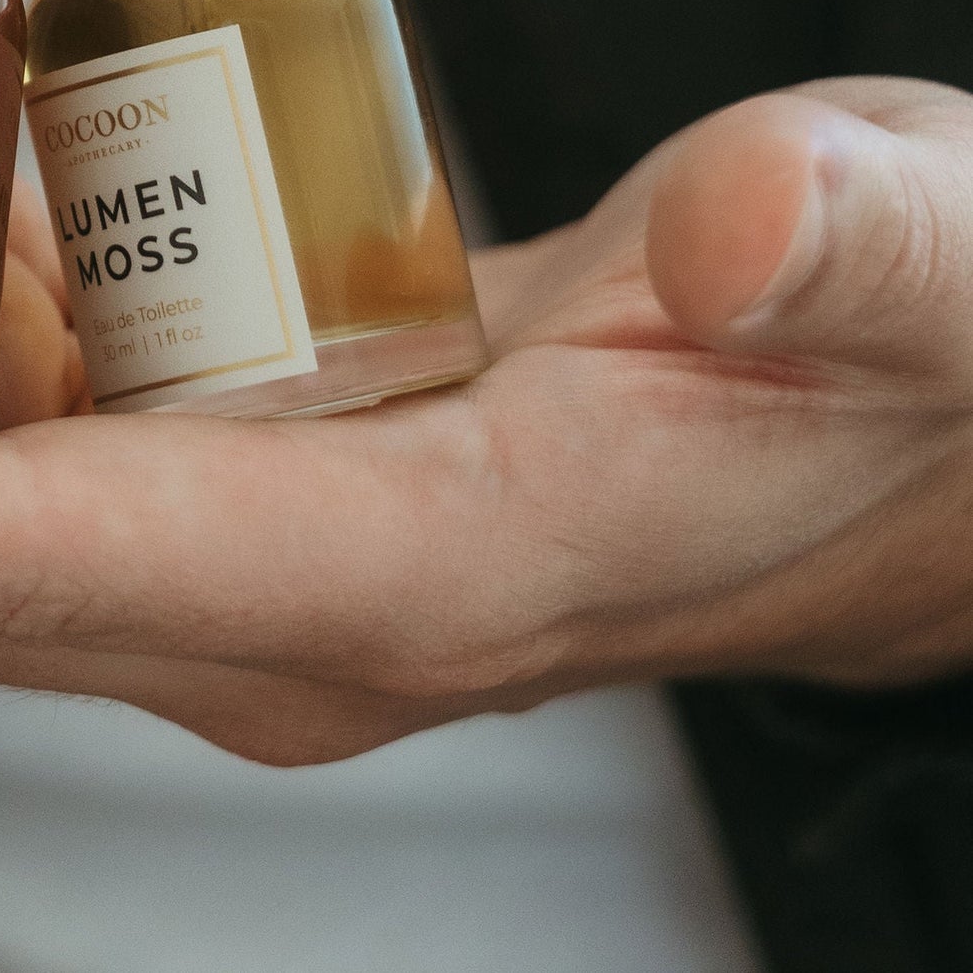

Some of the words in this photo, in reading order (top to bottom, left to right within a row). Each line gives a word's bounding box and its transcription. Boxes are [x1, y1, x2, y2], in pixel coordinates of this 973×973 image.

[45, 94, 170, 153] COCOON
[57, 169, 206, 241] LUMEN
[77, 227, 198, 291] MOSS
[117, 310, 135, 329] de
[136, 297, 204, 323] Toilette
[118, 335, 136, 357] ml
[181, 325, 204, 342] oz
